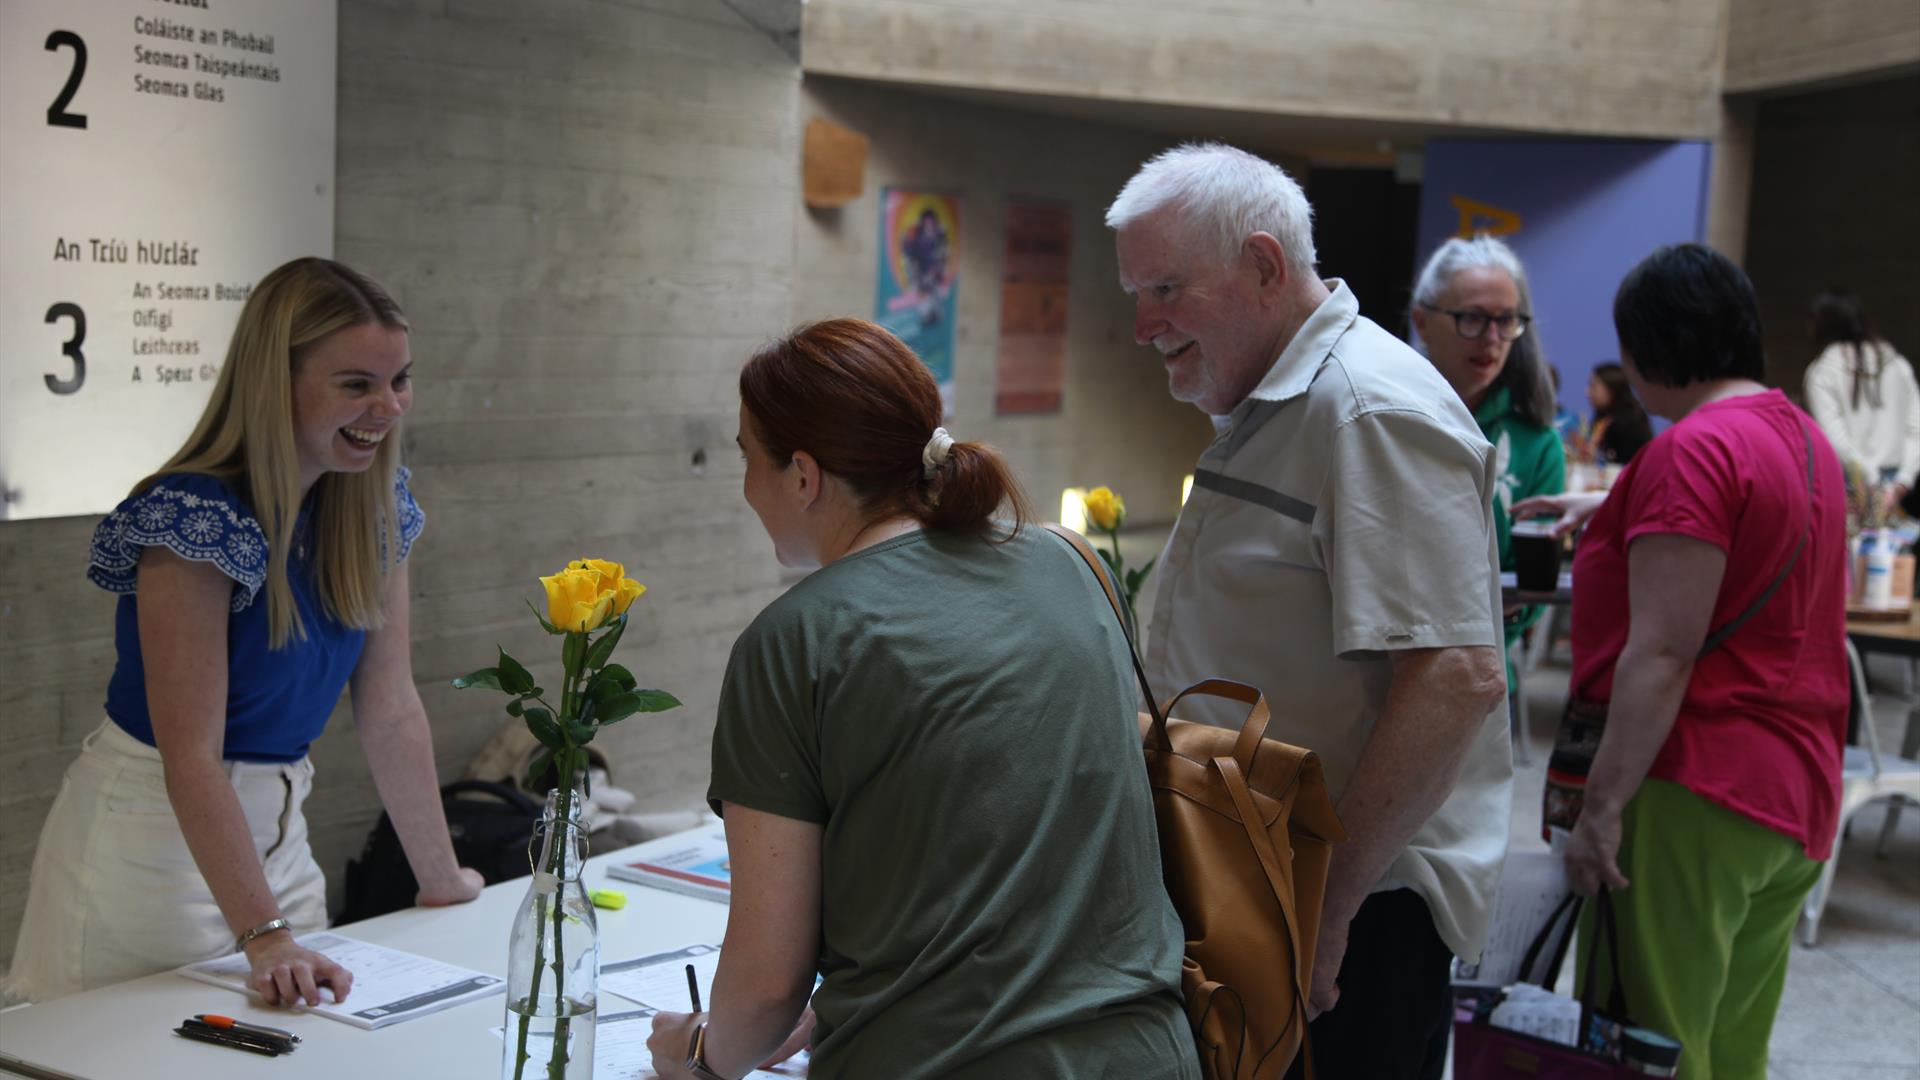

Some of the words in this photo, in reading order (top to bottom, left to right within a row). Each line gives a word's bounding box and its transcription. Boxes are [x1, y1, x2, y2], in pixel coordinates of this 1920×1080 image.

[134, 16, 194, 42] Coláiste
[200, 29, 218, 45] an
[222, 29, 275, 54] Phobail
[44, 29, 88, 129] 2
[134, 45, 189, 69] Seomra
[194, 52, 280, 82] Taispeántais
[134, 73, 189, 98] Seomra
[193, 81, 225, 102] Glas
[54, 237, 80, 261] An
[137, 239, 199, 266] hUrlár
[132, 282, 152, 298] An
[157, 282, 210, 300] Seomra
[44, 302, 87, 395] 3
[132, 337, 200, 355] Leithreas
